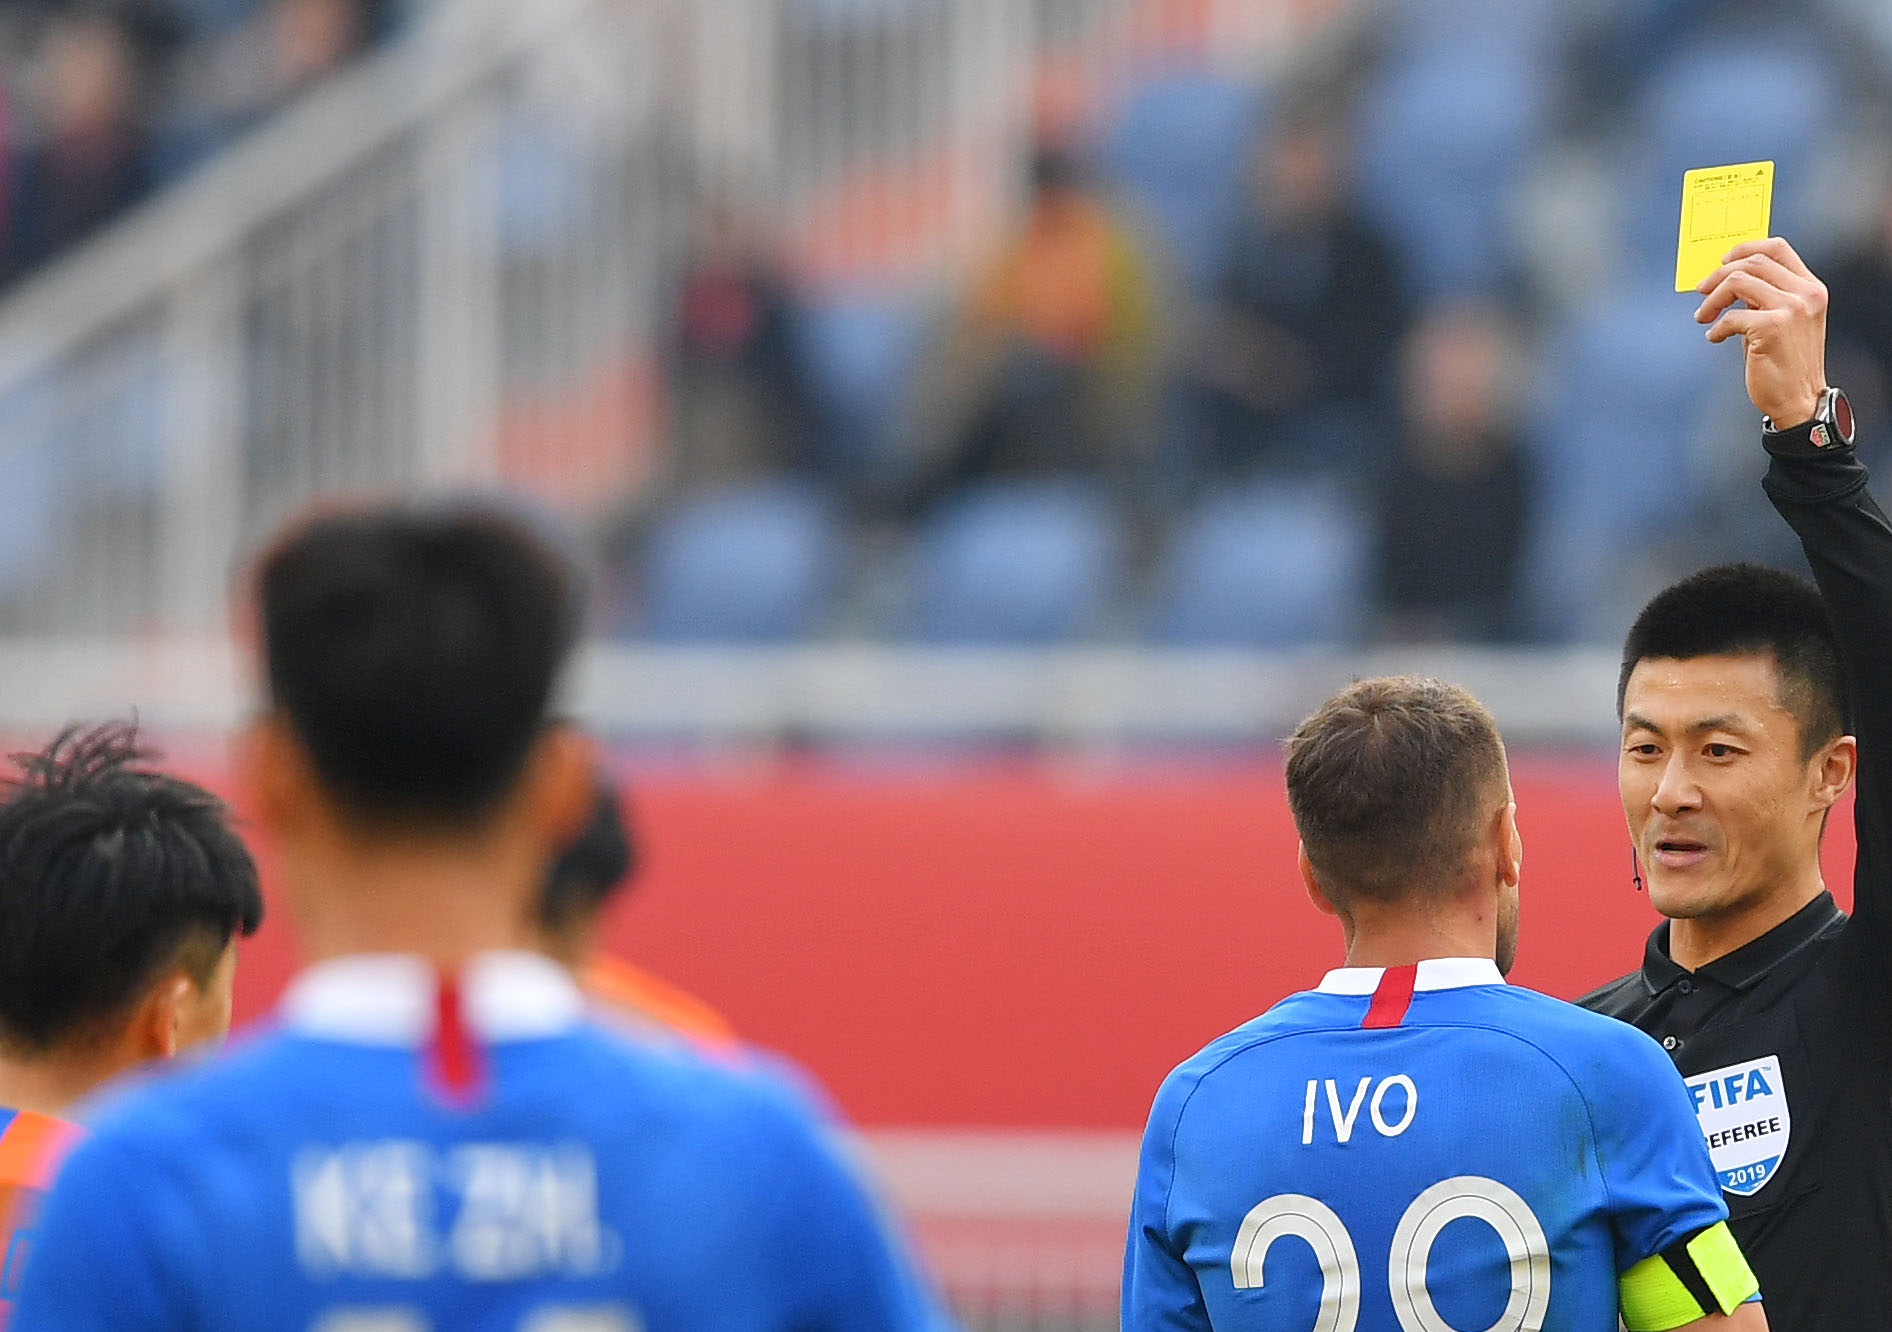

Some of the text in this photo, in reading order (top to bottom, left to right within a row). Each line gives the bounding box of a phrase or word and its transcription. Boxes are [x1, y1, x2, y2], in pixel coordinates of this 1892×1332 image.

[1302, 1074, 1418, 1144] IVO
[1688, 1068, 1773, 1114] FIFA
[1705, 1117, 1781, 1149] EFEREE
[1727, 1164, 1766, 1187] 2019
